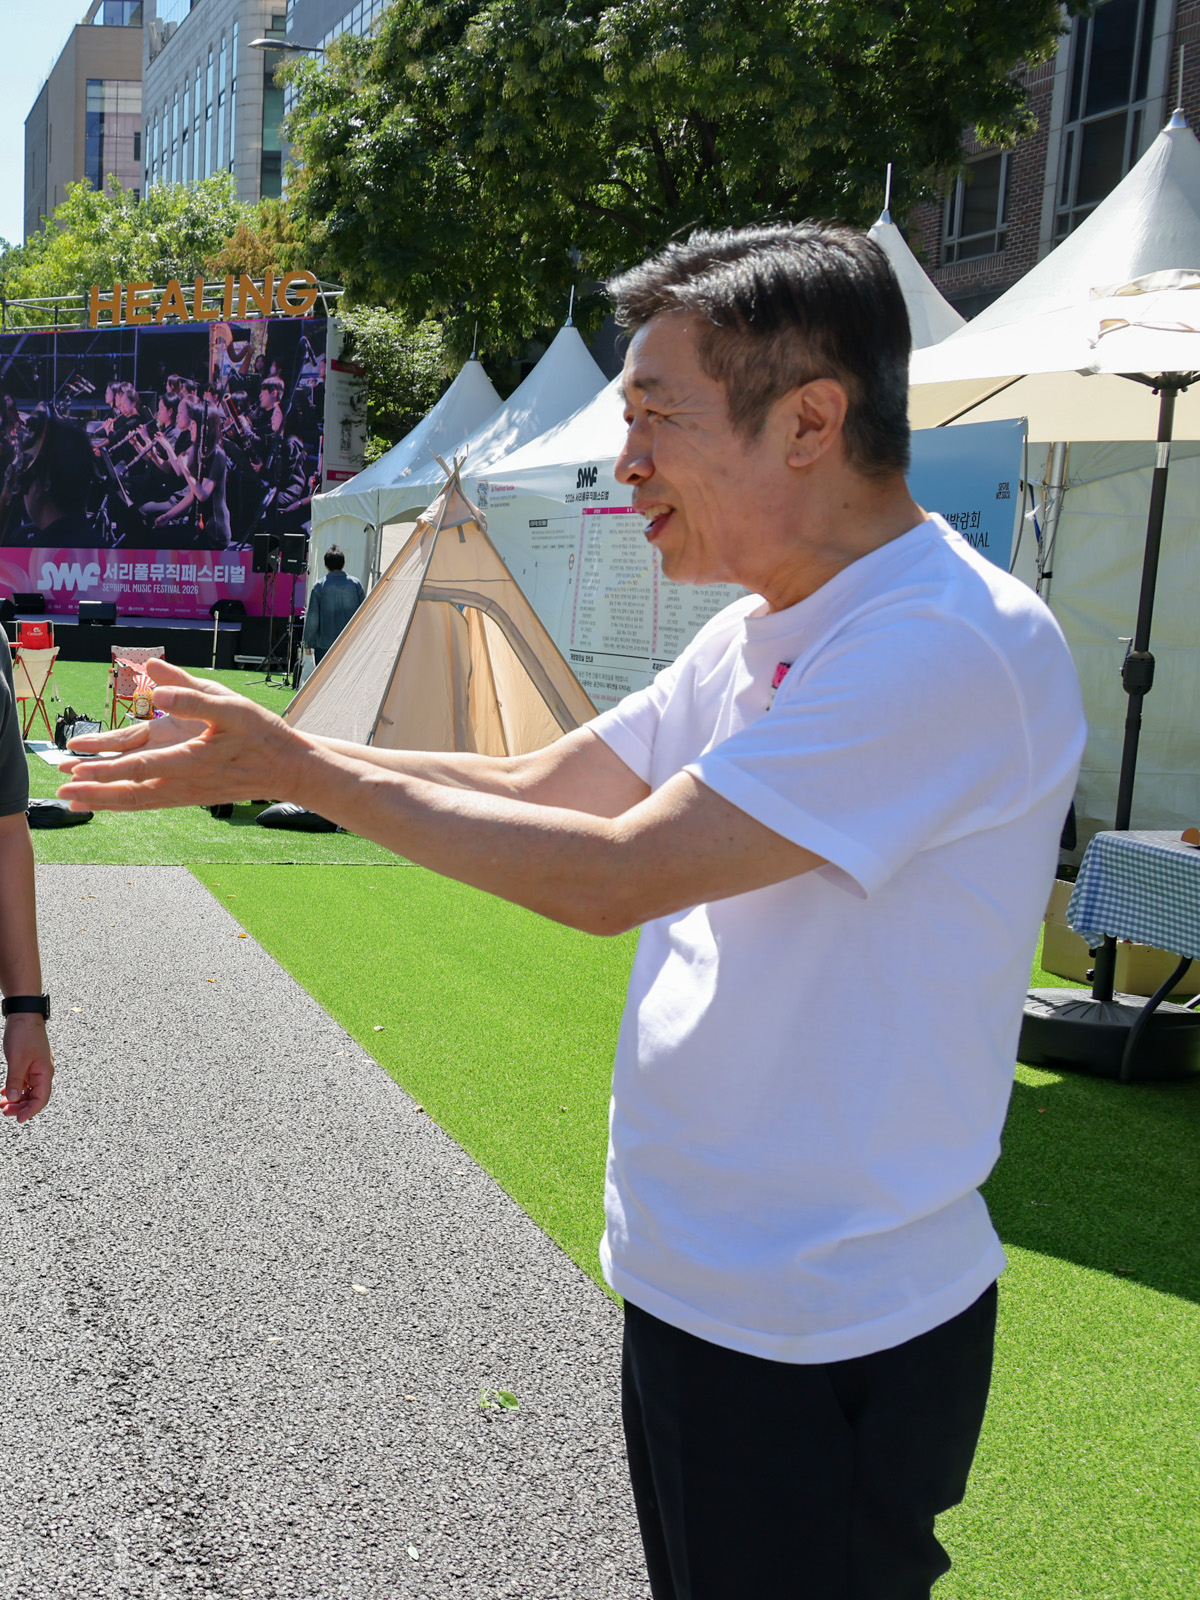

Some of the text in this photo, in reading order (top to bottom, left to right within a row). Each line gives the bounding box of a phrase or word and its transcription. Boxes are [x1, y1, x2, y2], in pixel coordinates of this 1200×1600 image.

[90, 269, 318, 326] HEALING
[576, 466, 598, 489] SMF
[37, 561, 101, 591] SMF
[103, 563, 246, 583] 서리풀뮤직페스티벌
[132, 584, 152, 593] MUSIC
[153, 584, 180, 594] FESTIVAL
[182, 585, 199, 595] 2026
